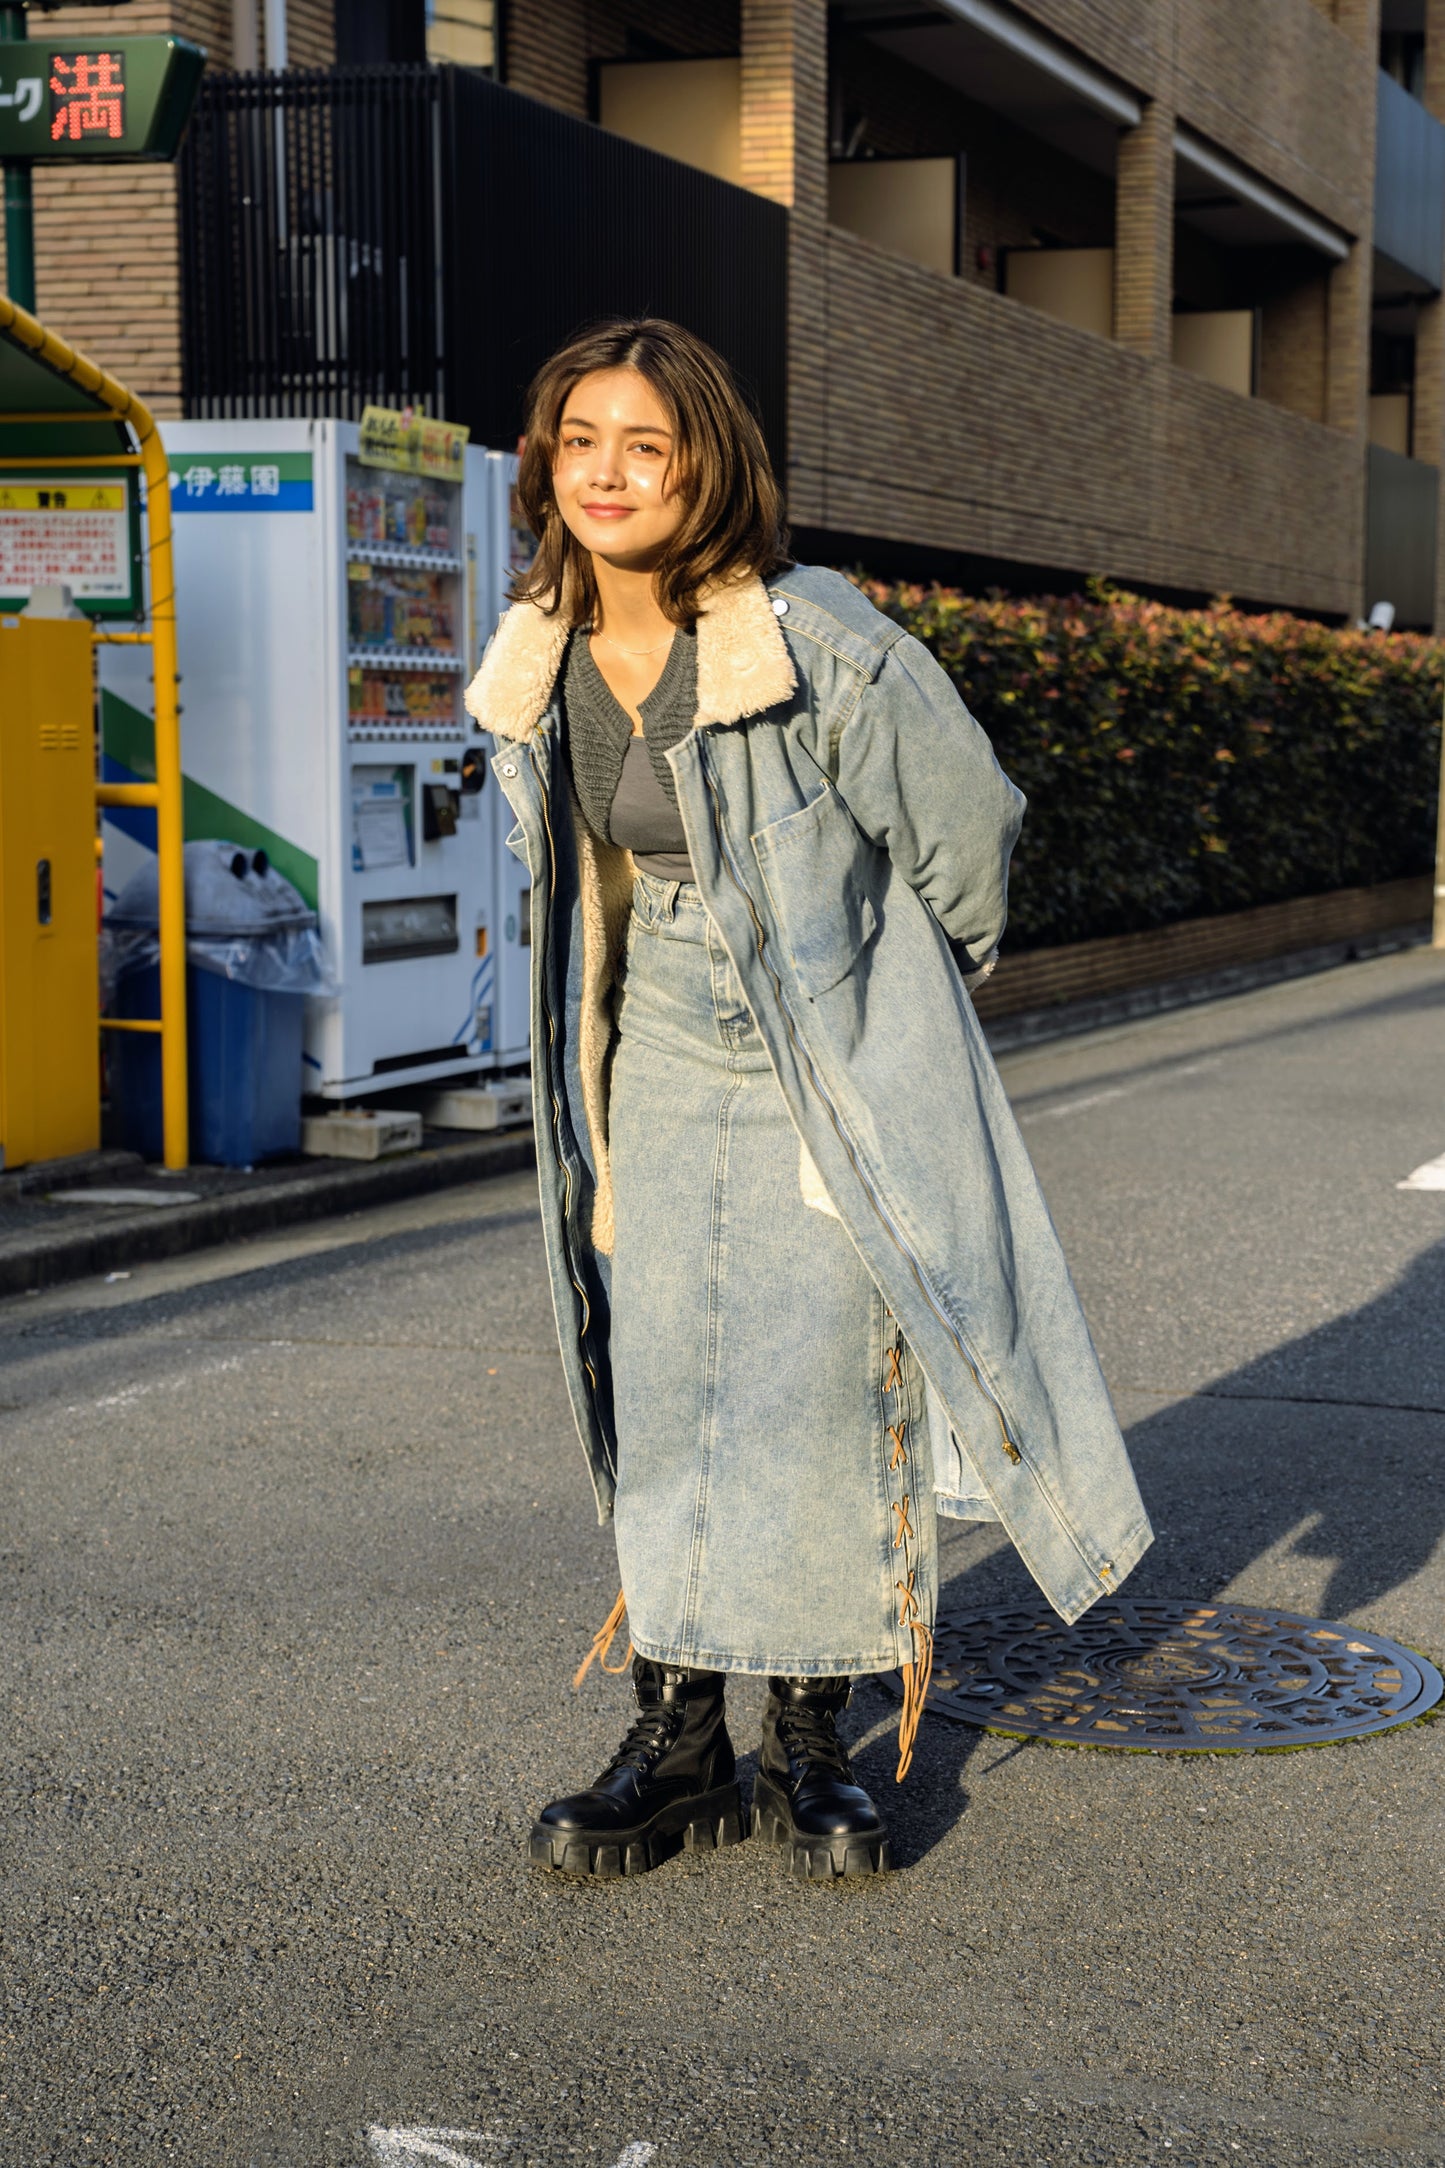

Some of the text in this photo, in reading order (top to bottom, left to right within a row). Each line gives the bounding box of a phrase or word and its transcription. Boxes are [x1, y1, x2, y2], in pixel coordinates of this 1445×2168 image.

[50, 53, 124, 140] 満
[183, 464, 280, 497] 伊藤園
